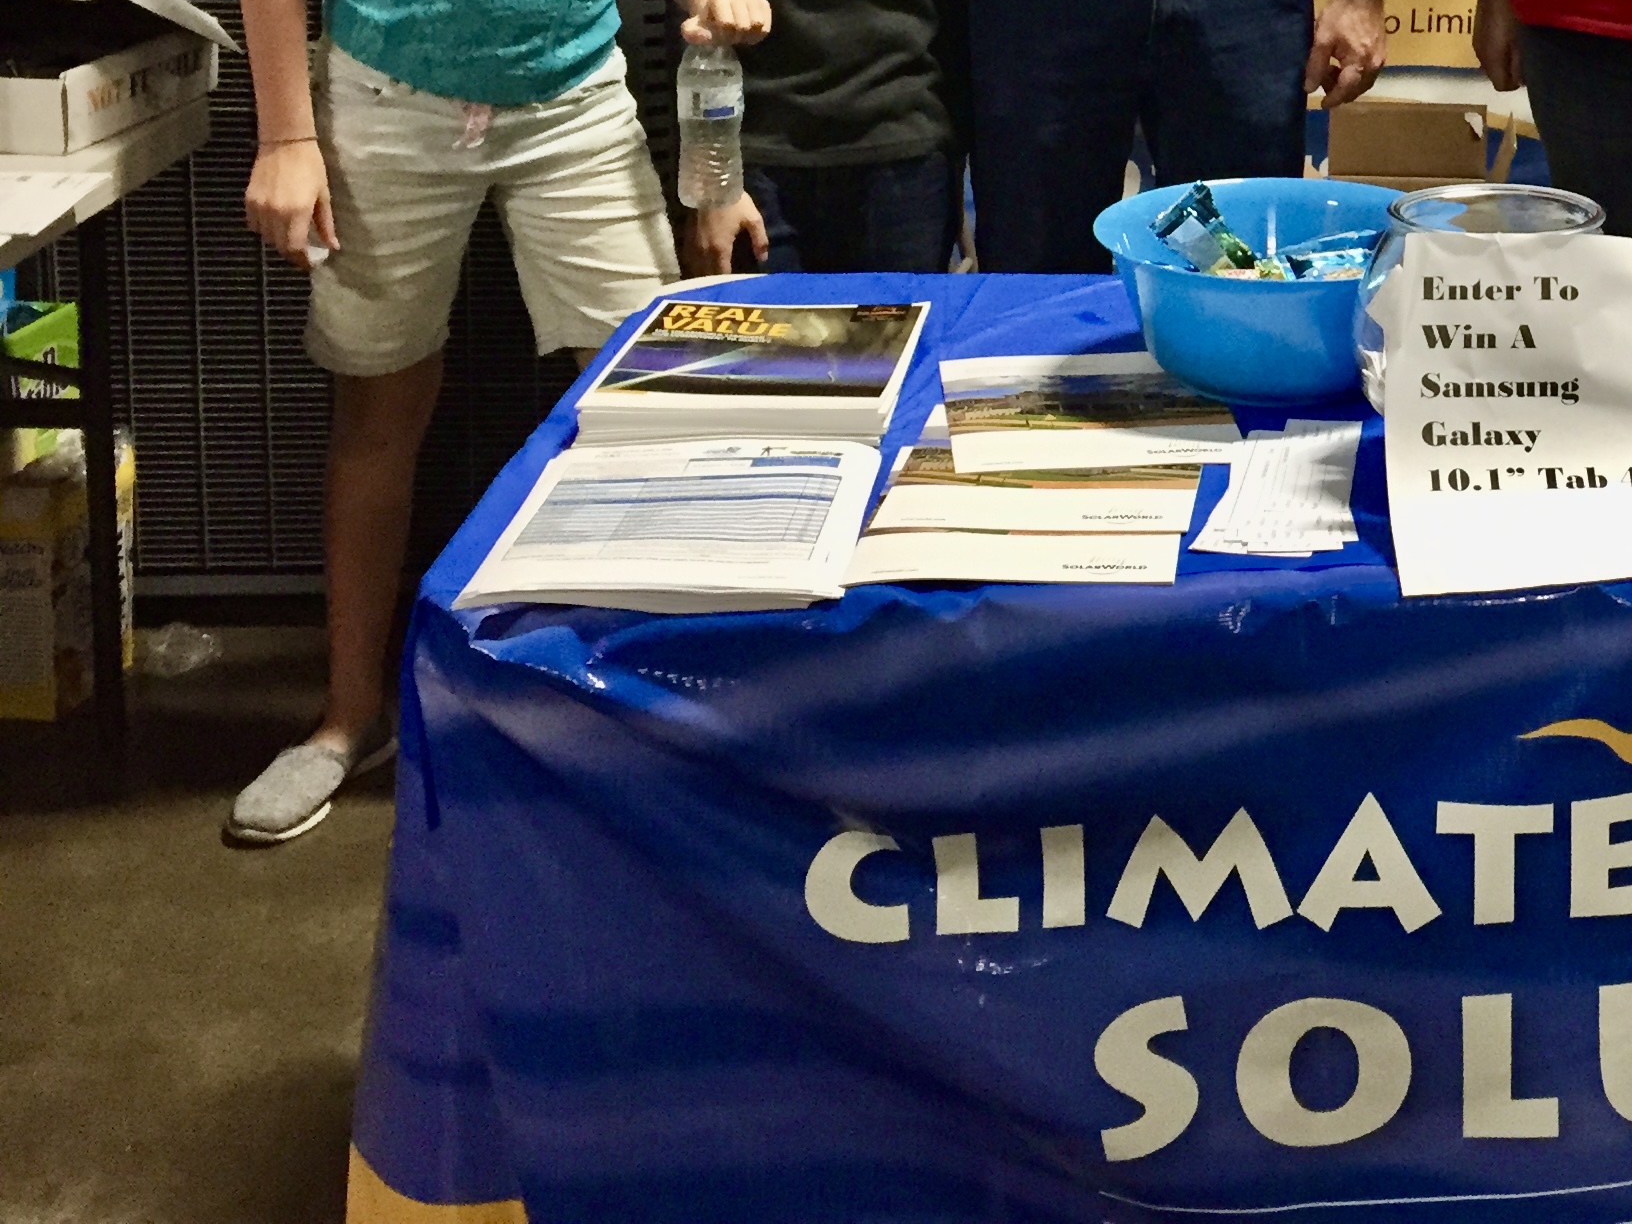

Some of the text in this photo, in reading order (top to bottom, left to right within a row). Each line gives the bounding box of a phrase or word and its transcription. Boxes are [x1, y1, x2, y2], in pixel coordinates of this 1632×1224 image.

[1421, 276, 1579, 301] Enter To
[668, 304, 766, 323] REAL
[663, 316, 792, 338] VALUE
[1421, 324, 1536, 349] Win A
[1420, 372, 1580, 405] Samsung
[1421, 421, 1542, 452] Galaxy
[1538, 467, 1607, 489] Tab
